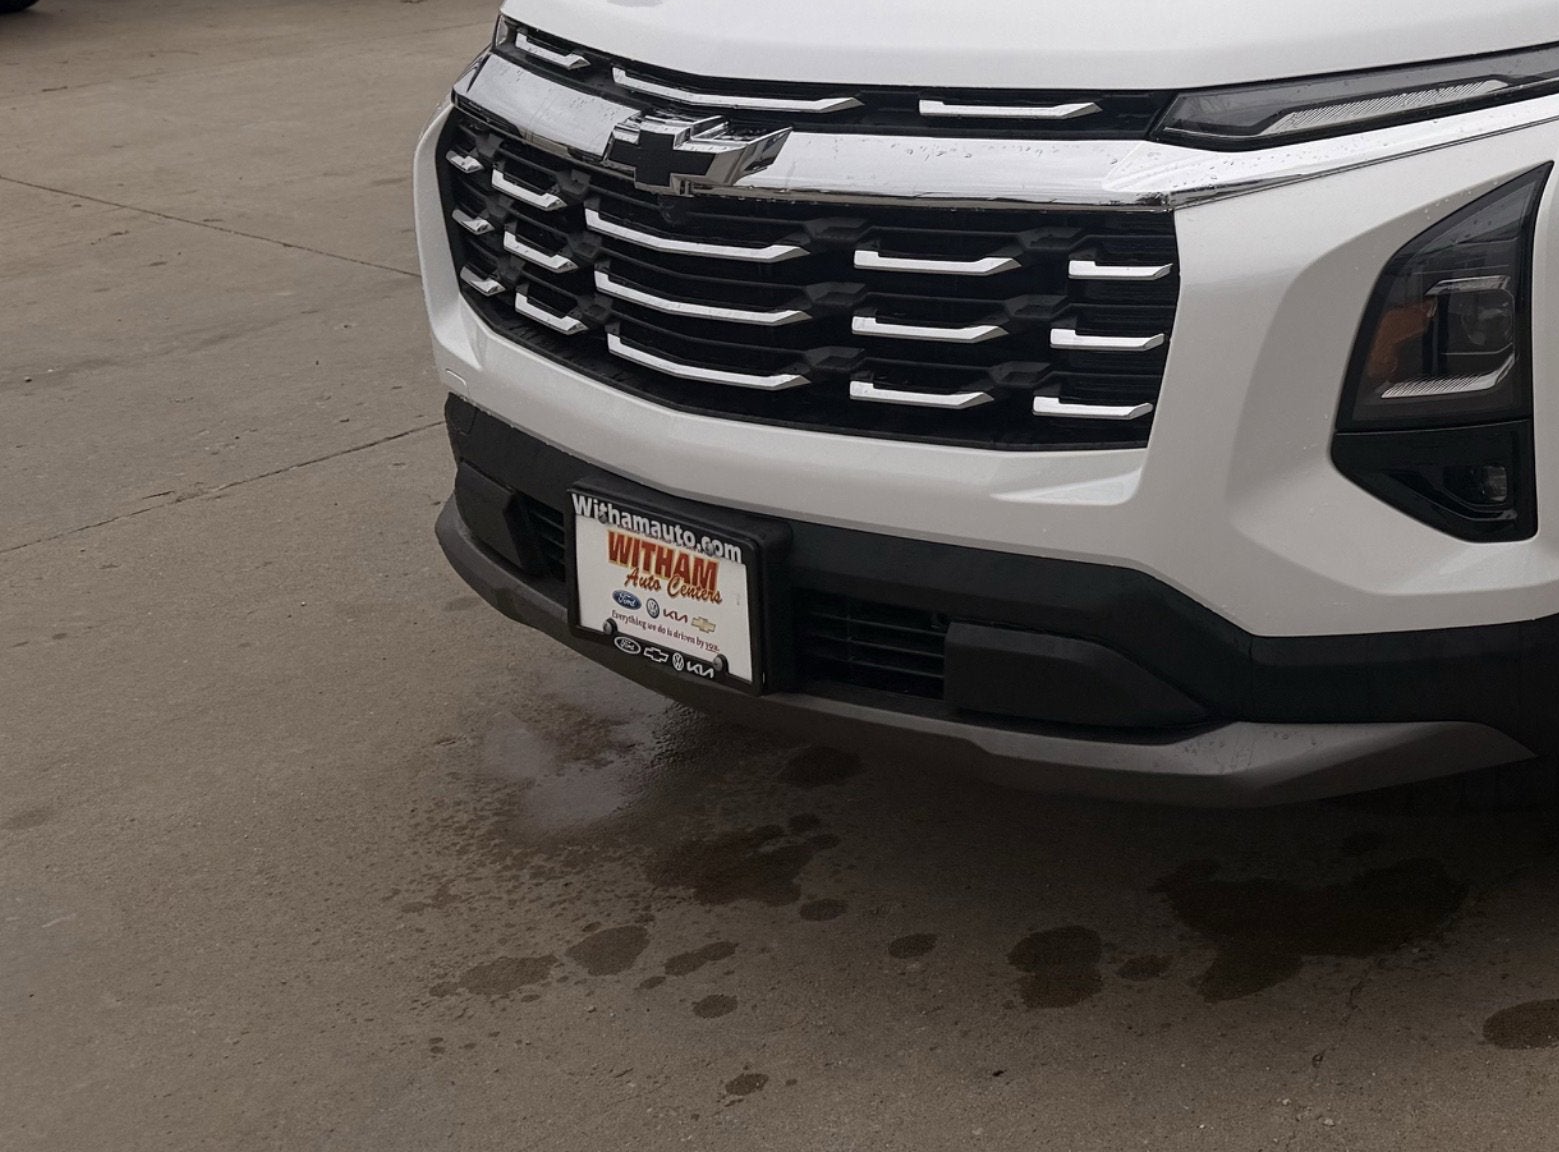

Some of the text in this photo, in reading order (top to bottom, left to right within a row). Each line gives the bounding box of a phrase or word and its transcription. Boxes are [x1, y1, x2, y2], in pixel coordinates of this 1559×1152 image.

[571, 493, 743, 564] Withamauto.com
[607, 530, 720, 592] WITHAM
[624, 567, 723, 605] Auto Centers
